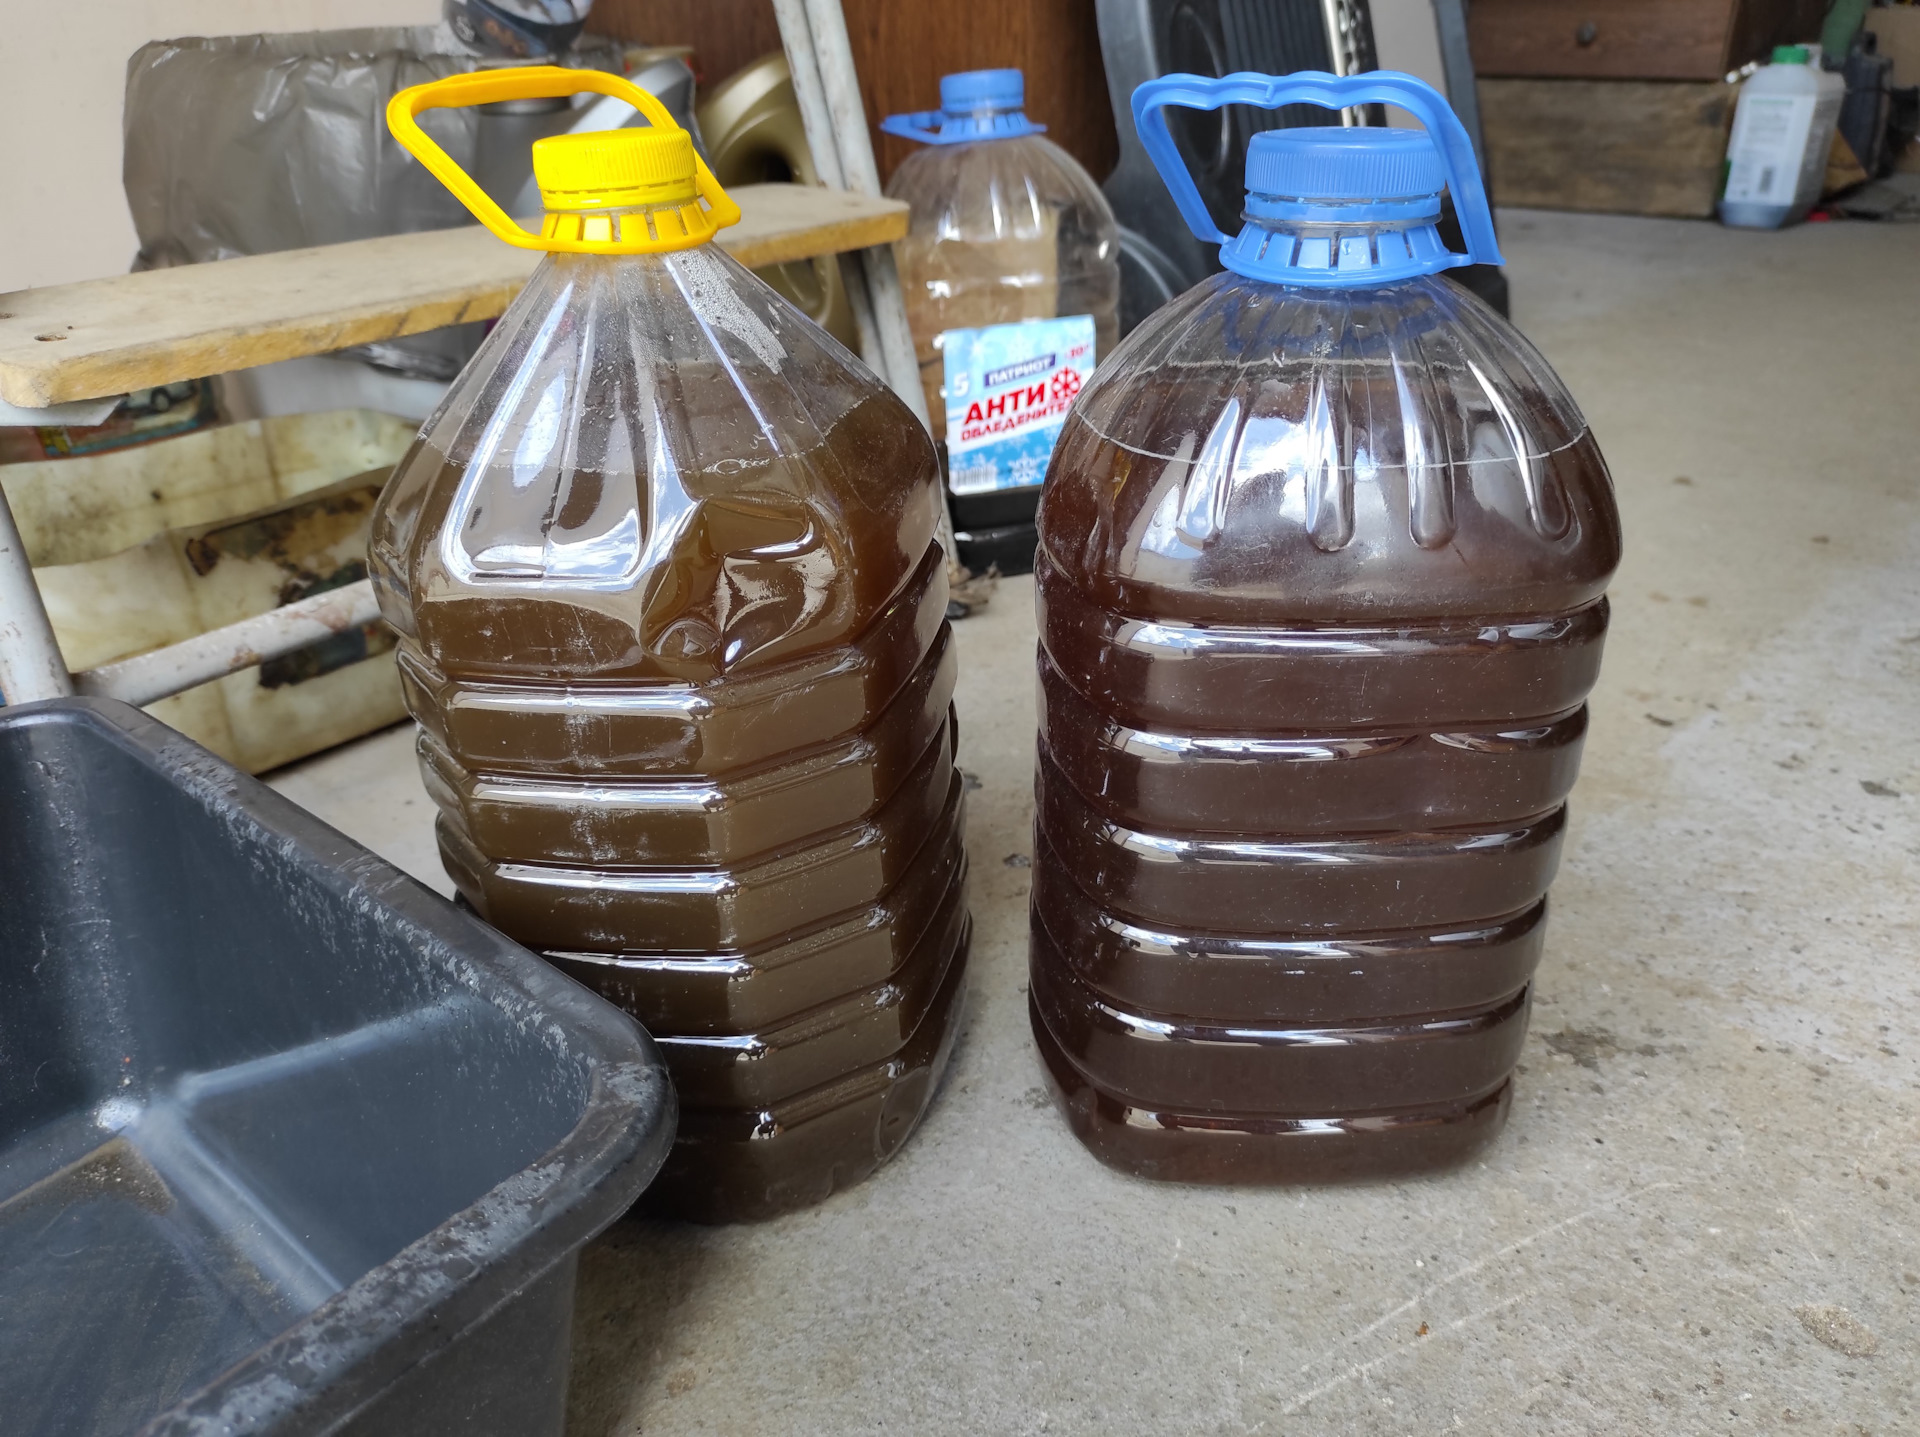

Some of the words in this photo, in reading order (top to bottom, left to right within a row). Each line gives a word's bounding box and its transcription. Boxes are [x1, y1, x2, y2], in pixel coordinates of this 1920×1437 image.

[988, 359, 1050, 384] ПАТРИОТ
[953, 373, 969, 397] 5
[964, 383, 1045, 425] АНТИ
